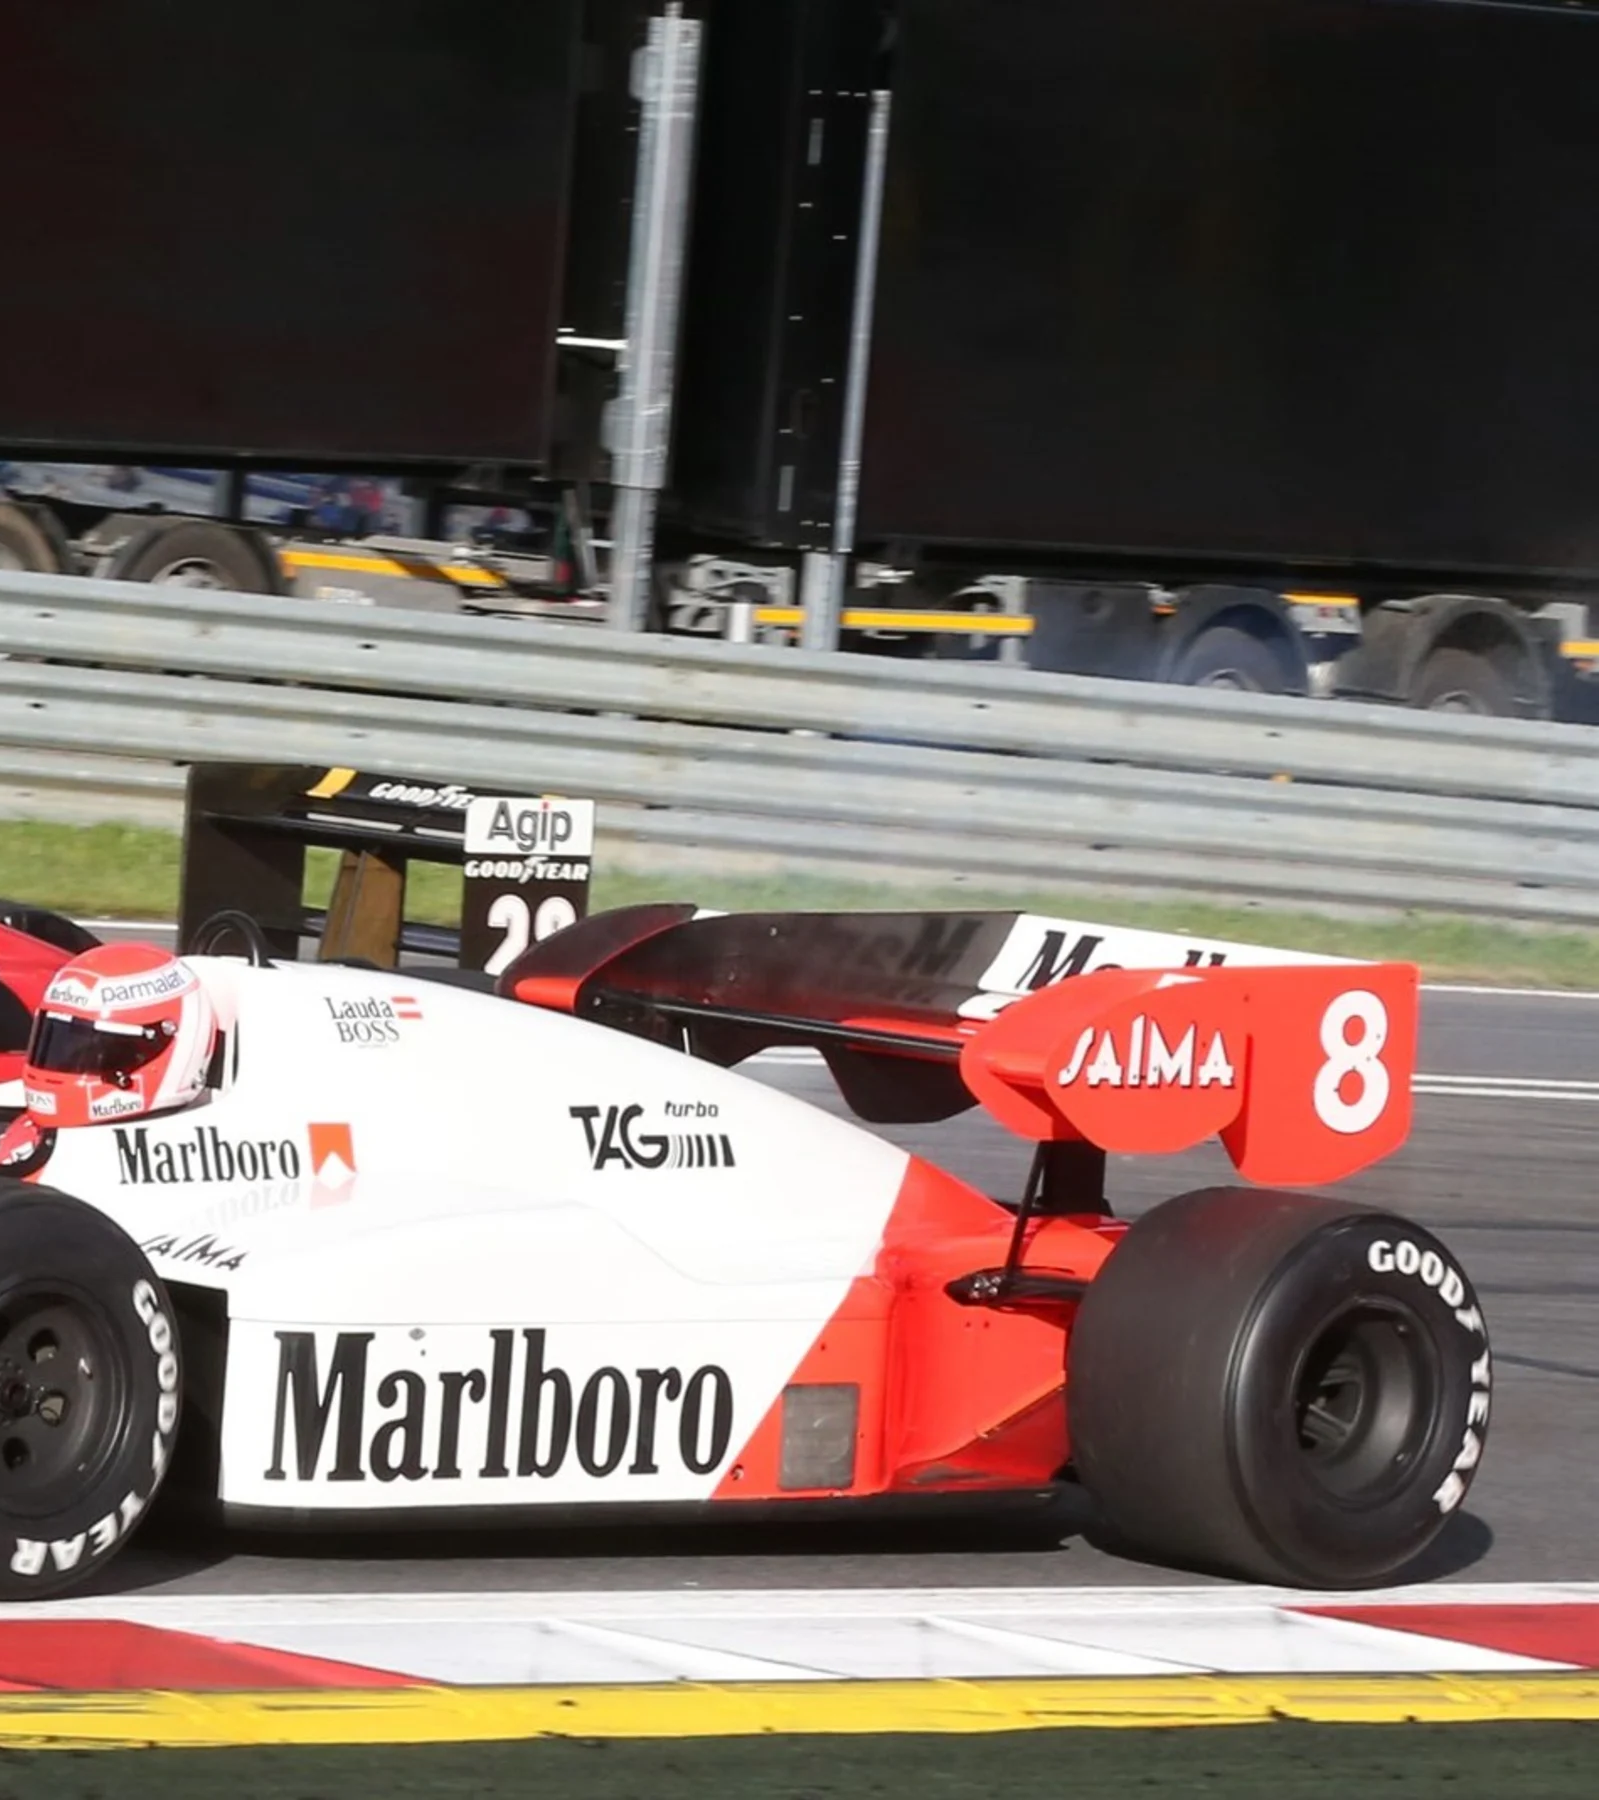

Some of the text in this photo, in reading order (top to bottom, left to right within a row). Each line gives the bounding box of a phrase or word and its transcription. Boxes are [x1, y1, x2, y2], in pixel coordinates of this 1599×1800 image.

[487, 800, 573, 852] Agip
[101, 970, 187, 1004] parmalat
[323, 996, 396, 1020] Lauda
[335, 1019, 401, 1043] BOSS
[1057, 1013, 1237, 1089] SAIMA
[1313, 989, 1391, 1135] 8
[91, 1096, 143, 1118] Marlboro
[664, 1100, 720, 1118] turbo
[112, 1125, 302, 1185] Marlboro
[567, 1103, 671, 1171] TAG
[263, 1327, 734, 1483] Marlboro
